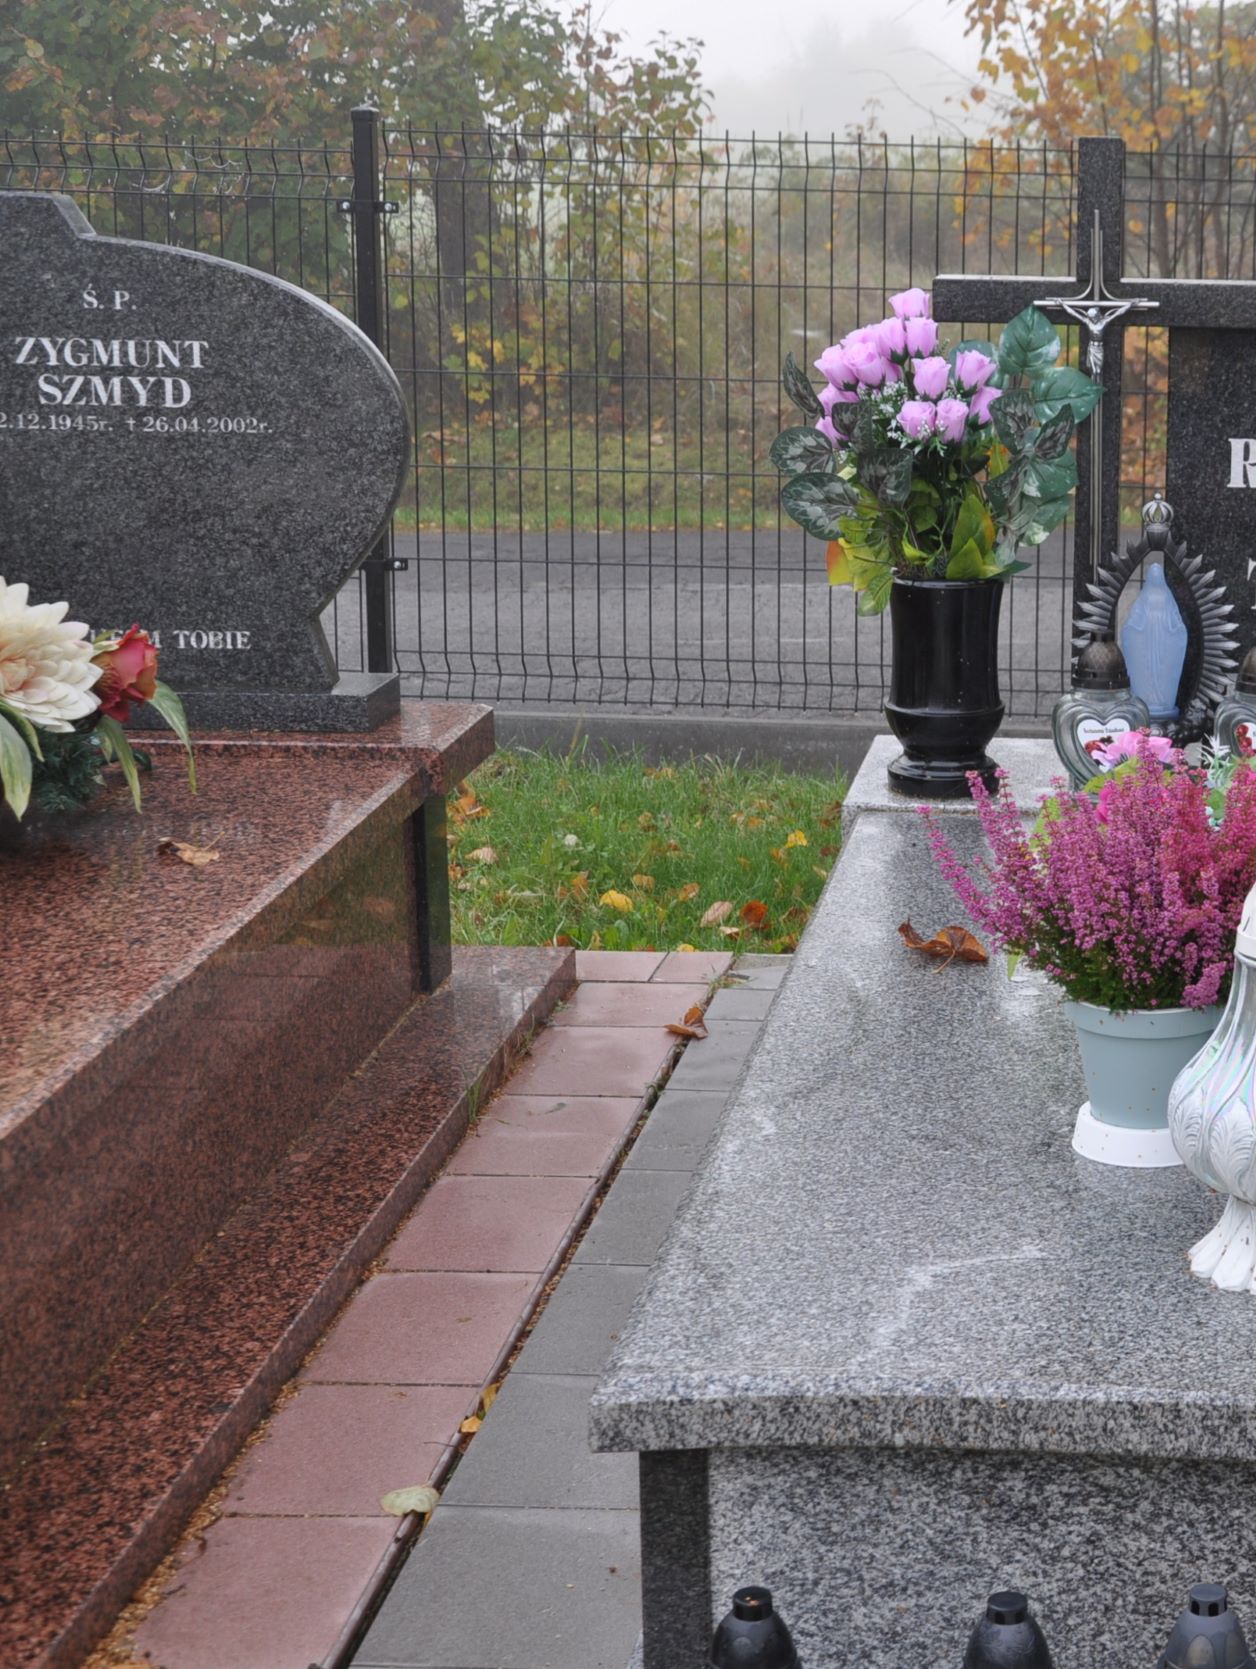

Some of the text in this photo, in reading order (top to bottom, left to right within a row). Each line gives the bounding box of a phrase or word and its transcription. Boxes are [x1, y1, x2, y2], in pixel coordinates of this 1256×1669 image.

[113, 290, 137, 310] P.
[15, 336, 209, 369] ZYGMUNT
[37, 372, 192, 409] SZMYD
[142, 415, 273, 434] 26.04.2002r.
[172, 629, 252, 650] TOBIE
